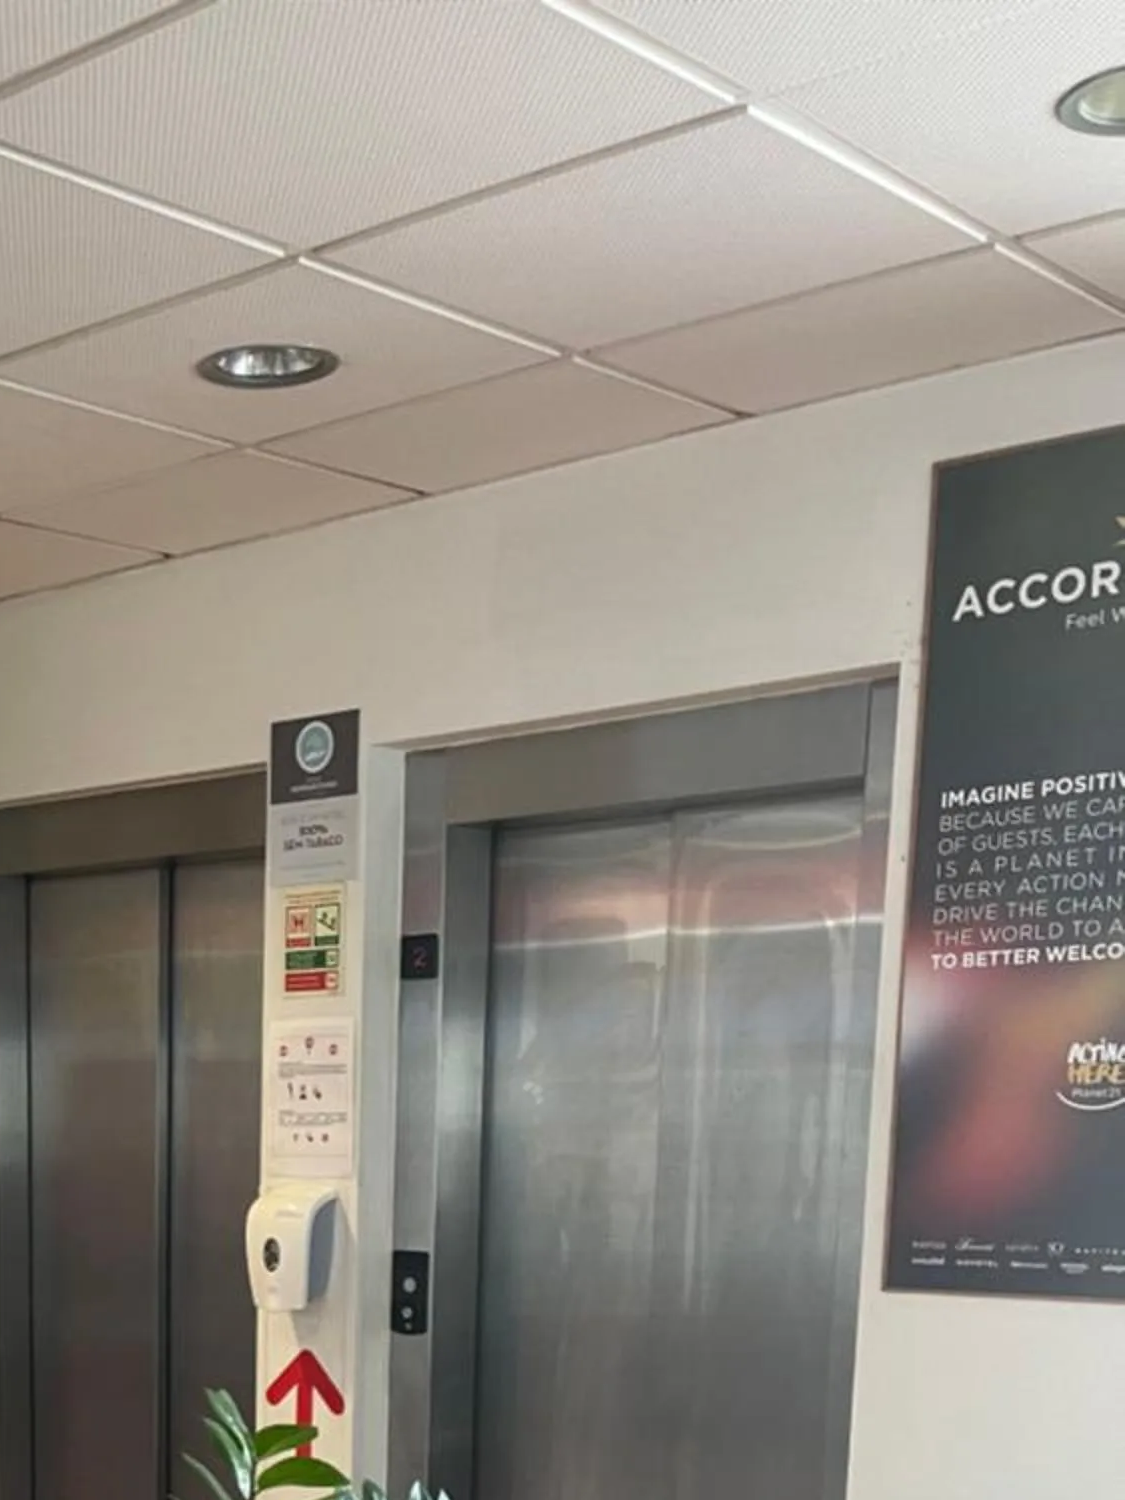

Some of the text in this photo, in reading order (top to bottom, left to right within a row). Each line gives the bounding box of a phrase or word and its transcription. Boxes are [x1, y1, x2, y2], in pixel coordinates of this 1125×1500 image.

[952, 561, 1121, 622] ACCOR
[1065, 608, 1105, 631] Feel
[940, 781, 1035, 809] IMAGINE
[939, 805, 1036, 833] BECAUSE
[1043, 800, 1078, 820] WE
[938, 821, 1124, 856] OF GUESTS. EACH
[936, 860, 957, 880] IS
[968, 858, 983, 876] A
[994, 847, 1097, 874] PLANET
[934, 879, 1006, 902] EVERY
[1016, 872, 1104, 895] ACTION
[933, 894, 1123, 925] DRIVE THE CHAN
[933, 928, 973, 947] THE
[980, 922, 1064, 944] WORLD
[1072, 918, 1101, 938] TO
[931, 952, 956, 970] TO
[962, 947, 1039, 969] BETTER
